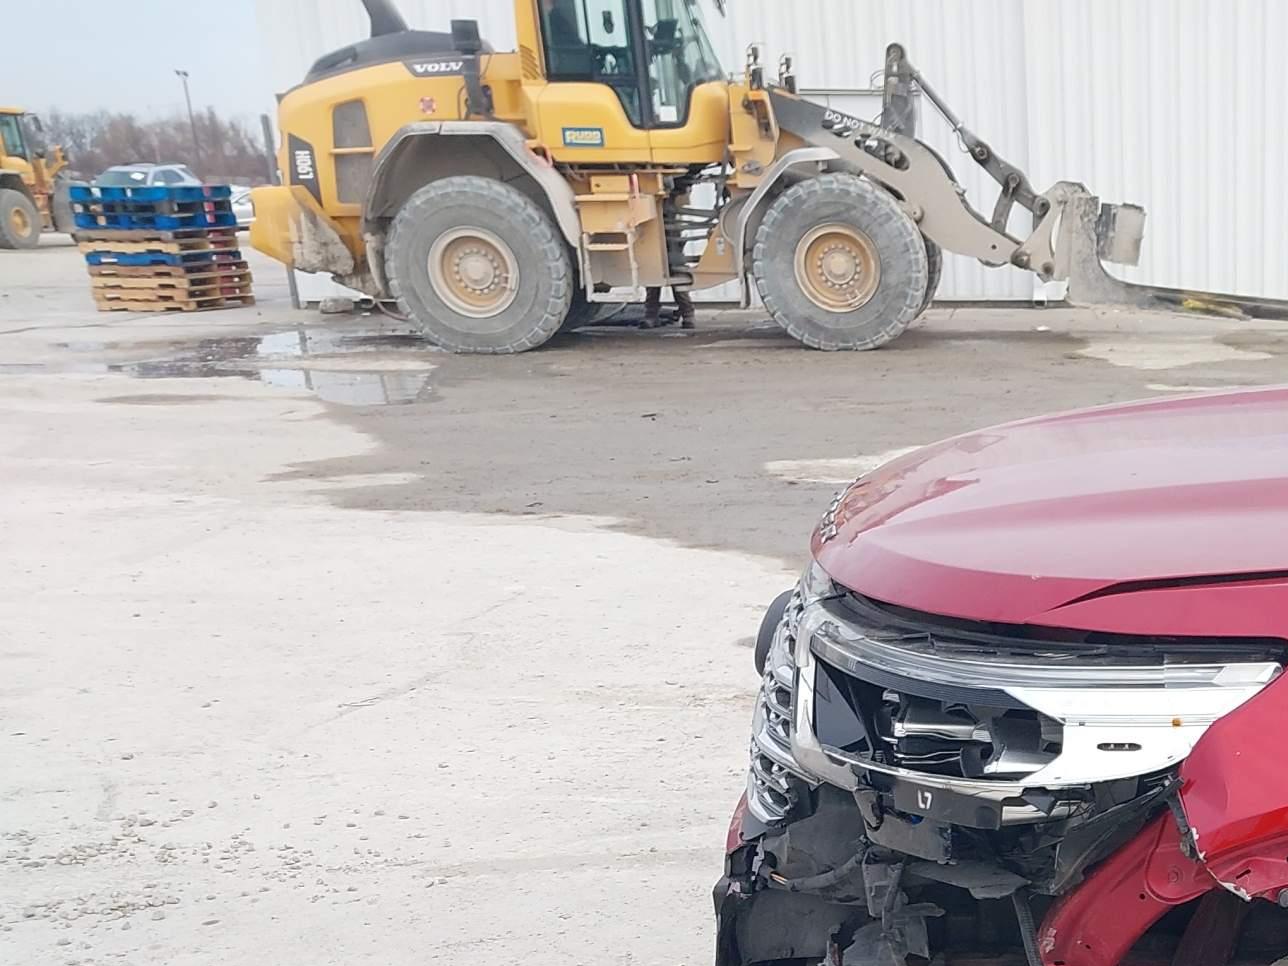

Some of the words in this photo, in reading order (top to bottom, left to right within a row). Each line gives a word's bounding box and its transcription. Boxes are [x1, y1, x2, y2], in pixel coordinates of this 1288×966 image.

[412, 61, 464, 73] VOLV
[823, 110, 842, 123] DO
[294, 150, 315, 179] L90H
